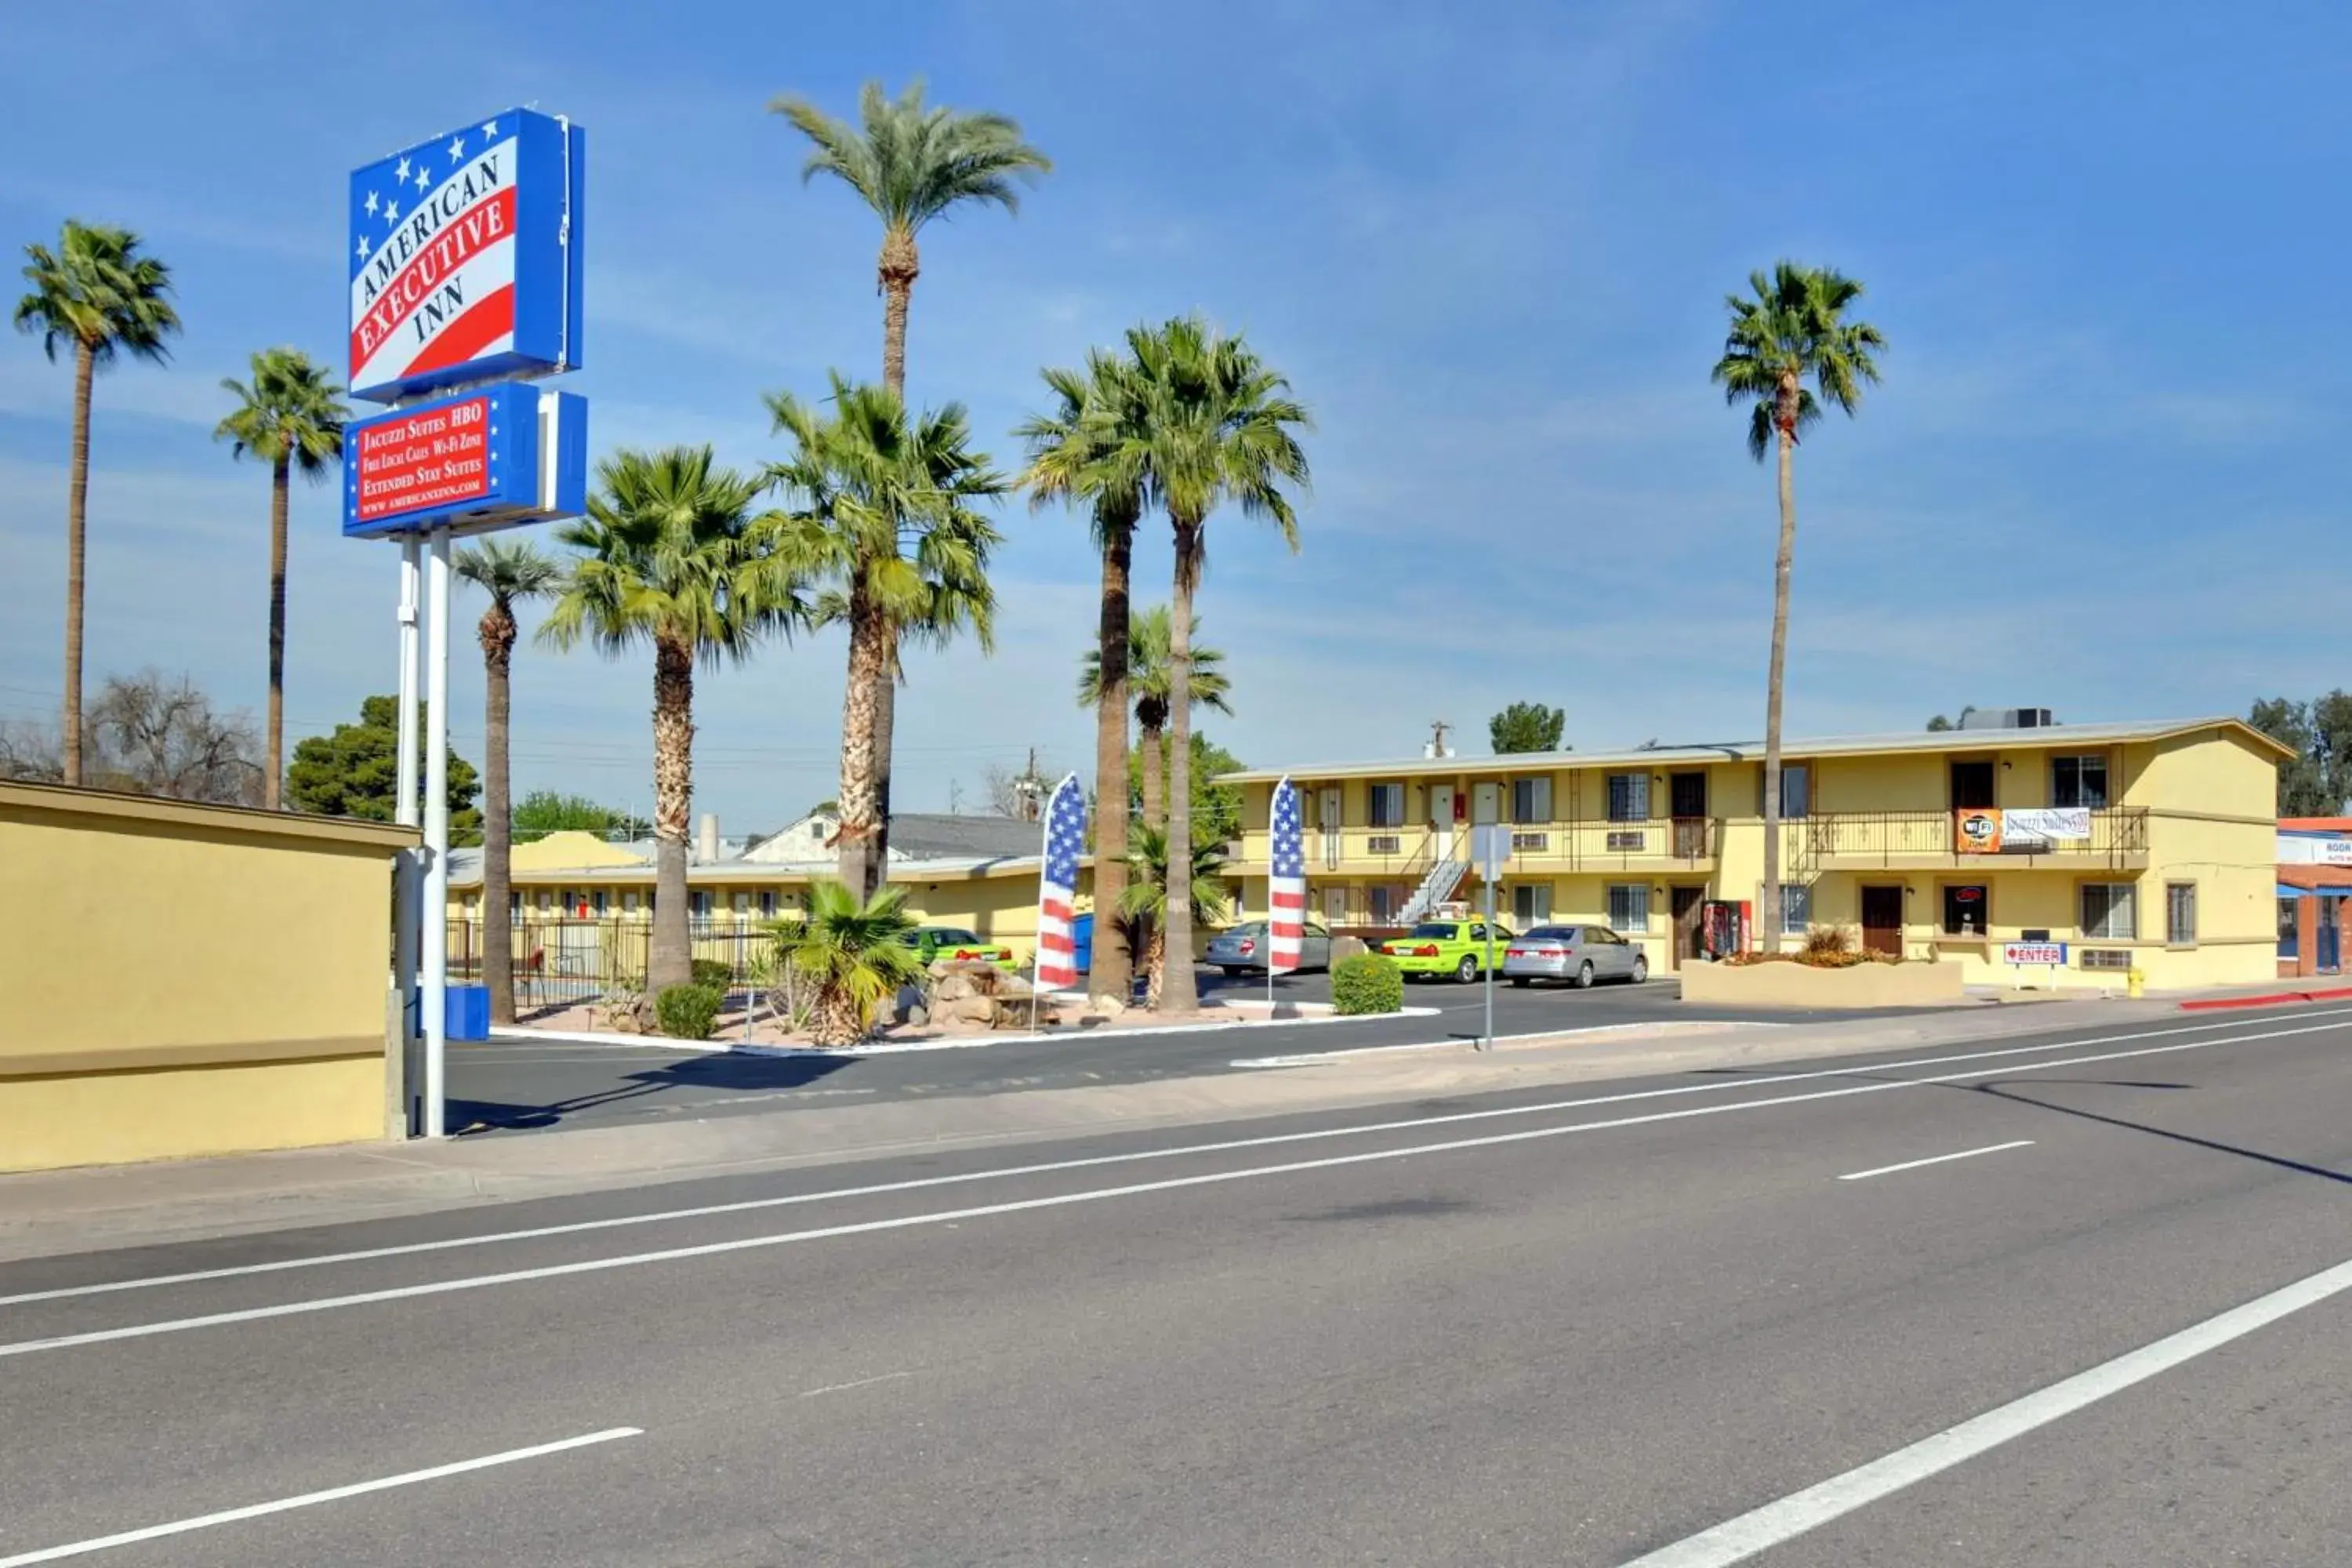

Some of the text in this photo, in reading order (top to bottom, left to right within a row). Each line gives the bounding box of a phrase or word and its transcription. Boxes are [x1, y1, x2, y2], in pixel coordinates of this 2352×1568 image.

[362, 155, 500, 306] AMERICAN
[358, 201, 505, 358] EXECUTIVE
[413, 274, 463, 343] INN
[451, 403, 481, 427] HBO
[2019, 949, 2059, 961] ENTER
